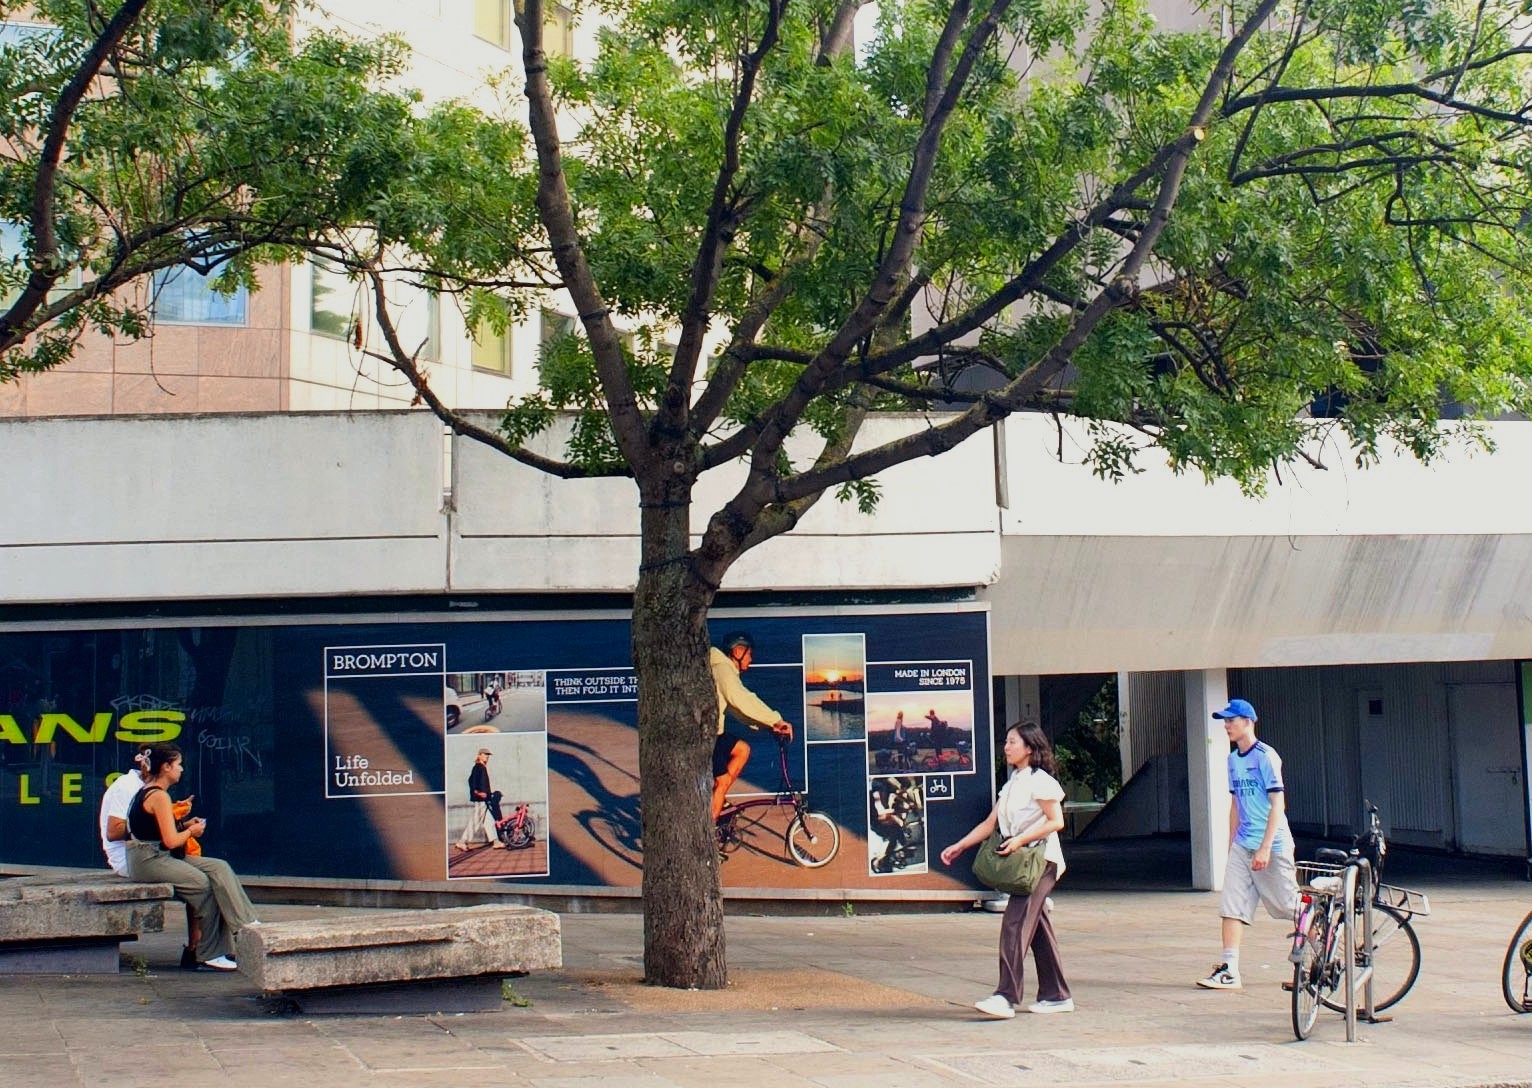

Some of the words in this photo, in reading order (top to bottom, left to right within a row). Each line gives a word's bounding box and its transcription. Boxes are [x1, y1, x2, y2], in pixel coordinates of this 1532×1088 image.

[333, 653, 438, 670] BROMPTON
[894, 669, 918, 677] MADE
[920, 669, 929, 677] IN
[931, 668, 966, 677] LONDON
[554, 677, 583, 686] THINK
[585, 676, 626, 685] OUTSIDE
[919, 677, 943, 685] SINCE
[555, 686, 581, 695] THEN
[583, 685, 608, 694] FOLD
[610, 685, 619, 693] IT
[622, 685, 638, 693] INT
[335, 755, 369, 770] Life
[335, 770, 414, 788] Unfolded
[20, 772, 125, 804] LE
